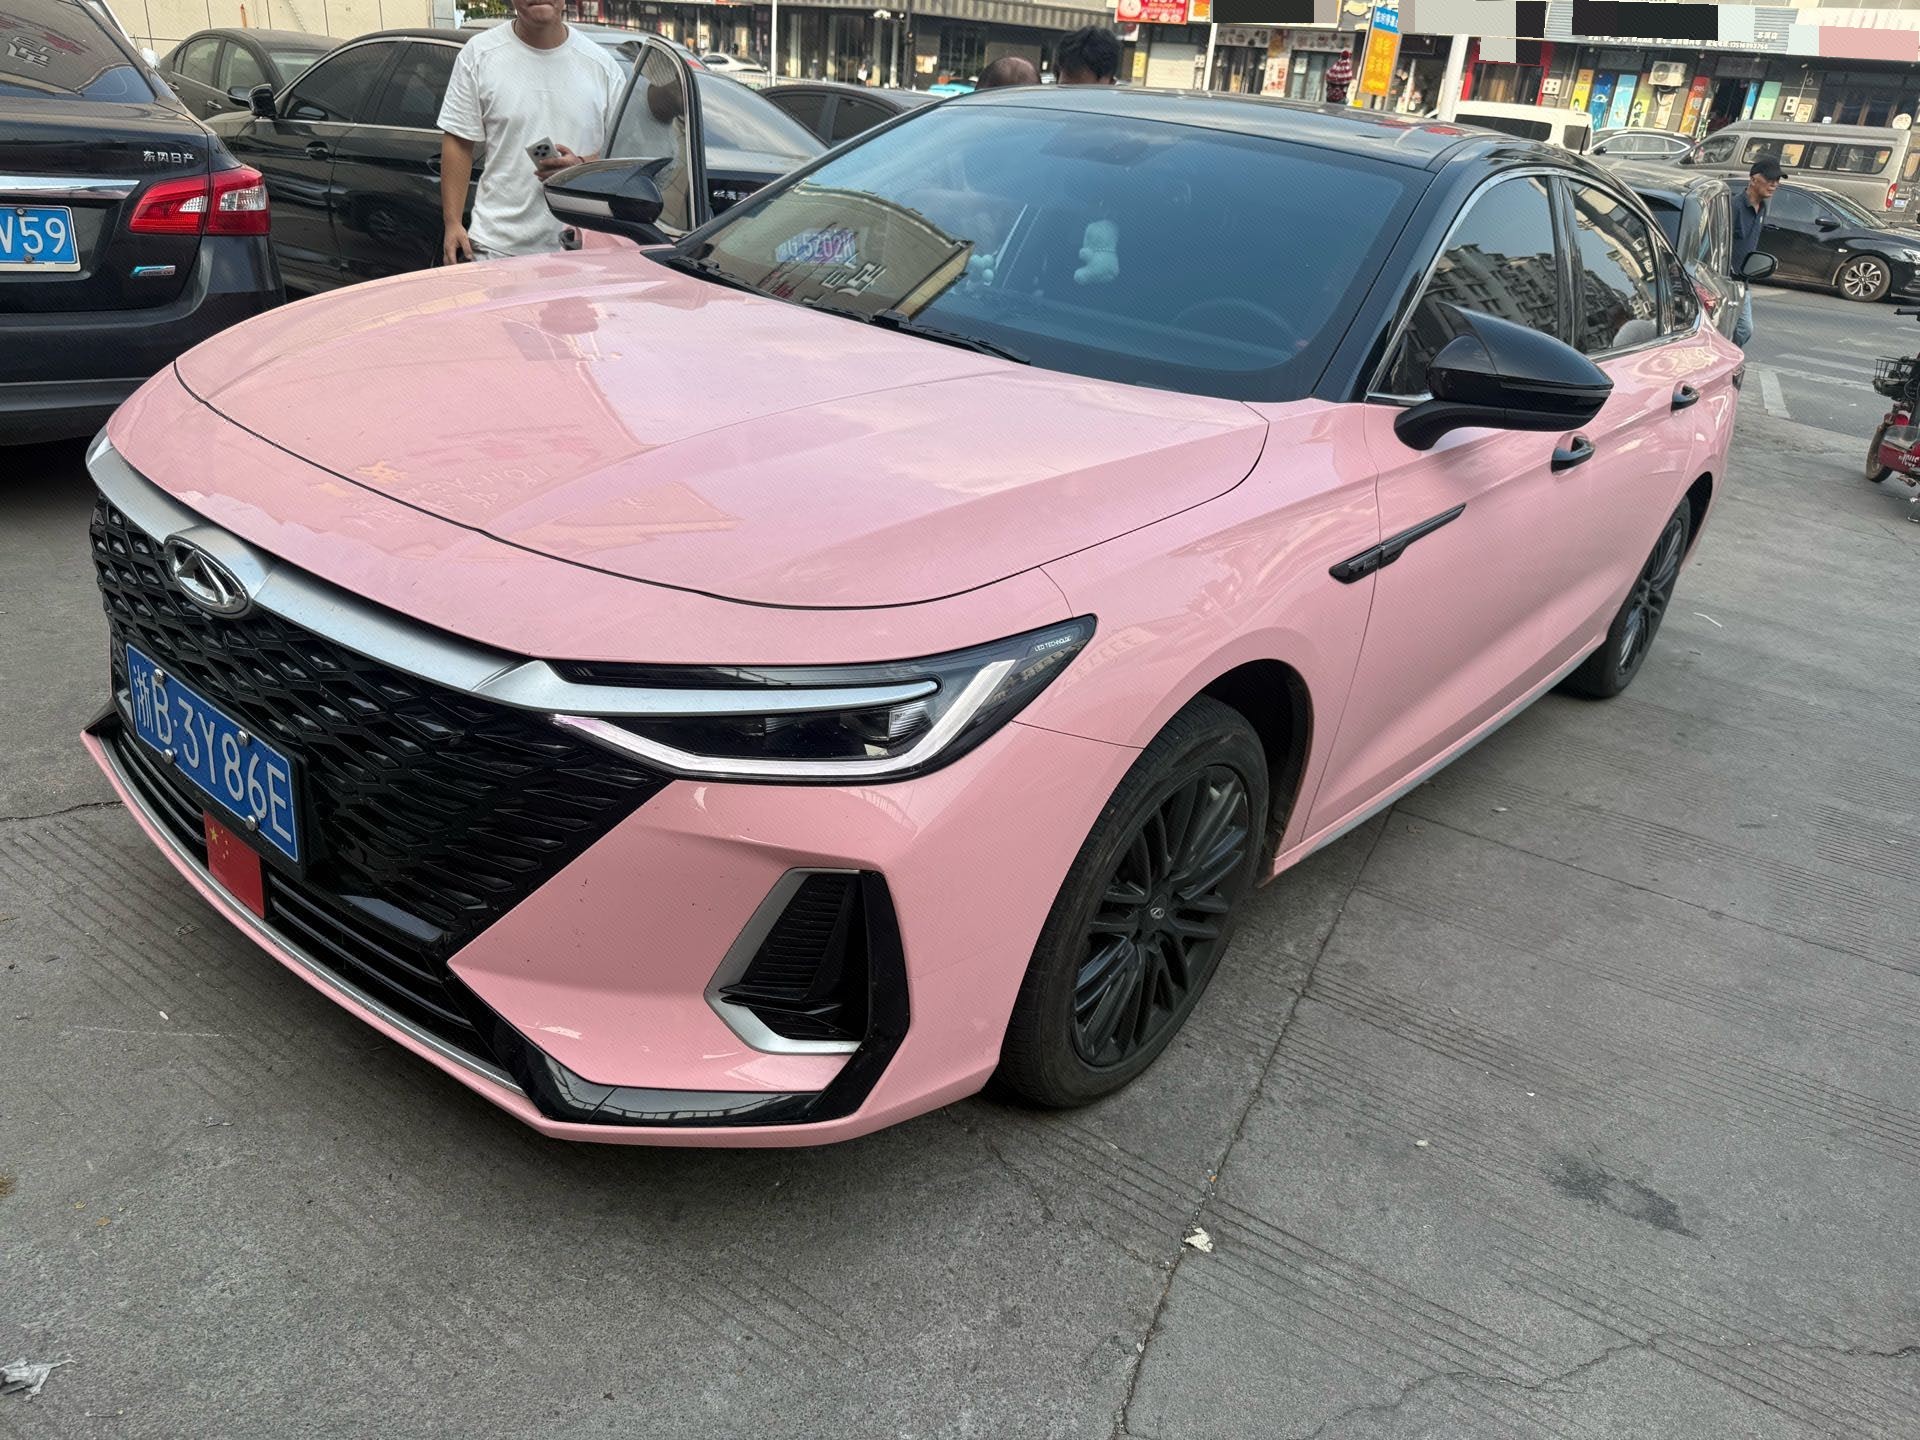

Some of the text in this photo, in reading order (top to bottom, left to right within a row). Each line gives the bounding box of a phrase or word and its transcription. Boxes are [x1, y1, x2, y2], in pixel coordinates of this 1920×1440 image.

[143, 150, 195, 164] 东风日产
[133, 664, 292, 844] 浙B·3Y86E
